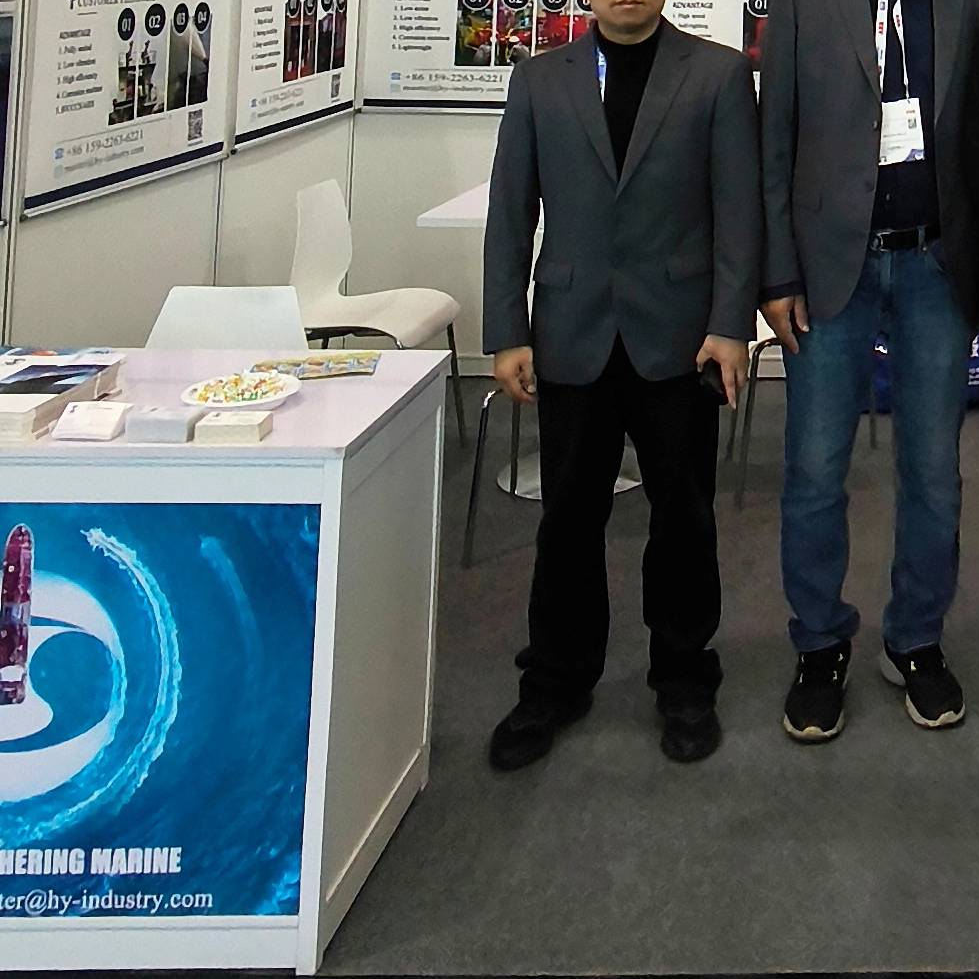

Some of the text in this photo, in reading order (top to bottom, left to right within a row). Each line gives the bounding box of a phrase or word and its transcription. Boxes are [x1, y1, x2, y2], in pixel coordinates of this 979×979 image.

[121, 19, 132, 32] 01
[148, 14, 161, 29] 02
[0, 846, 182, 875] HERING MARINE
